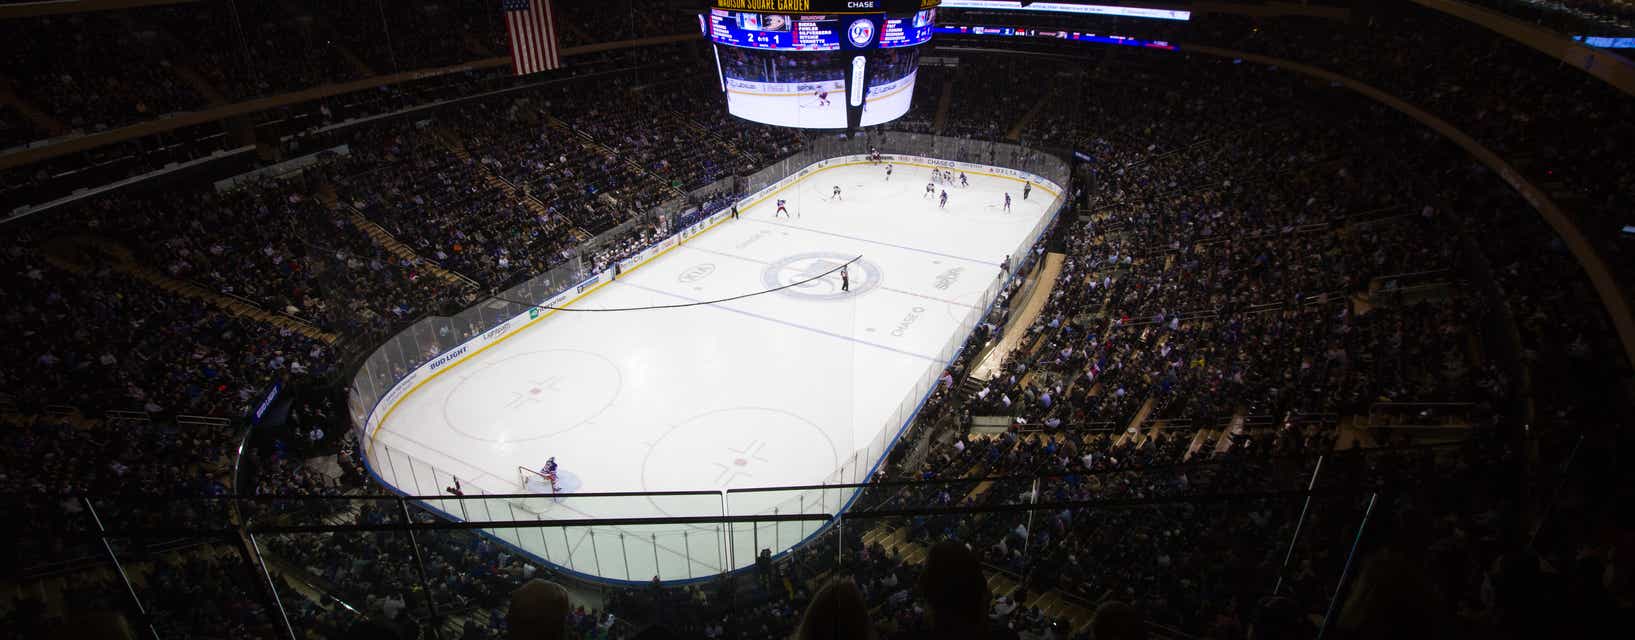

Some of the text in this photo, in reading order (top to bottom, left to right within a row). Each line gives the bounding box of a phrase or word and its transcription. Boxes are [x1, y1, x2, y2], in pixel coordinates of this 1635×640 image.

[717, 0, 810, 11] MADISON SQUARE GARDEN
[747, 33, 754, 42] 2
[773, 34, 779, 44] 1
[927, 159, 948, 167] CHASE
[995, 168, 1017, 176] DELTA
[890, 312, 920, 338] CHASE
[430, 346, 467, 370] BUD LIGHT
